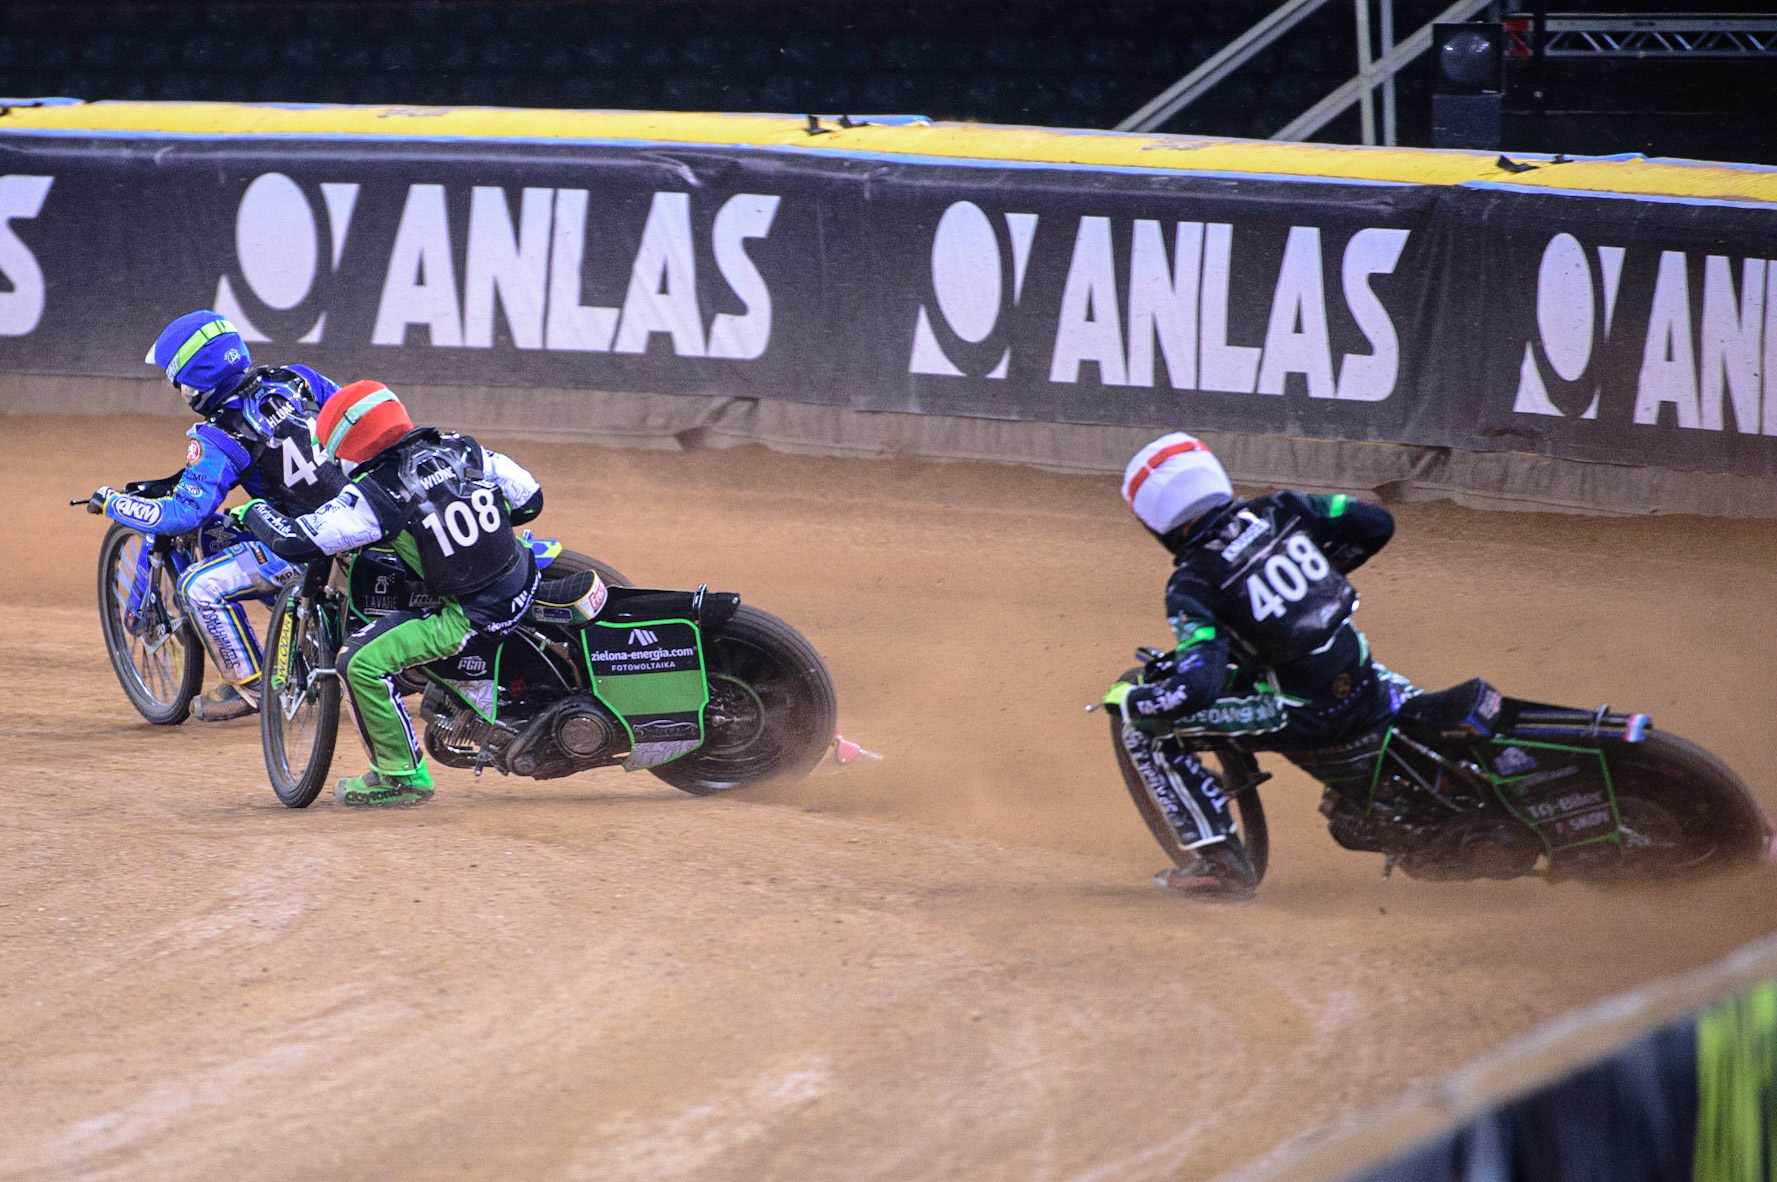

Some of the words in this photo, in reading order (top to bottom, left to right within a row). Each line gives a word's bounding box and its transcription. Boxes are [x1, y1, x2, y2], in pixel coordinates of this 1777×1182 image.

[372, 183, 781, 360] ANLAS
[1049, 214, 1411, 401] ANLAS
[115, 499, 160, 523] AKM
[422, 488, 501, 558] 108
[1246, 533, 1330, 622] 408
[591, 647, 694, 662] zielona-energia.com
[611, 661, 676, 671] FOTOWOLTAIKA
